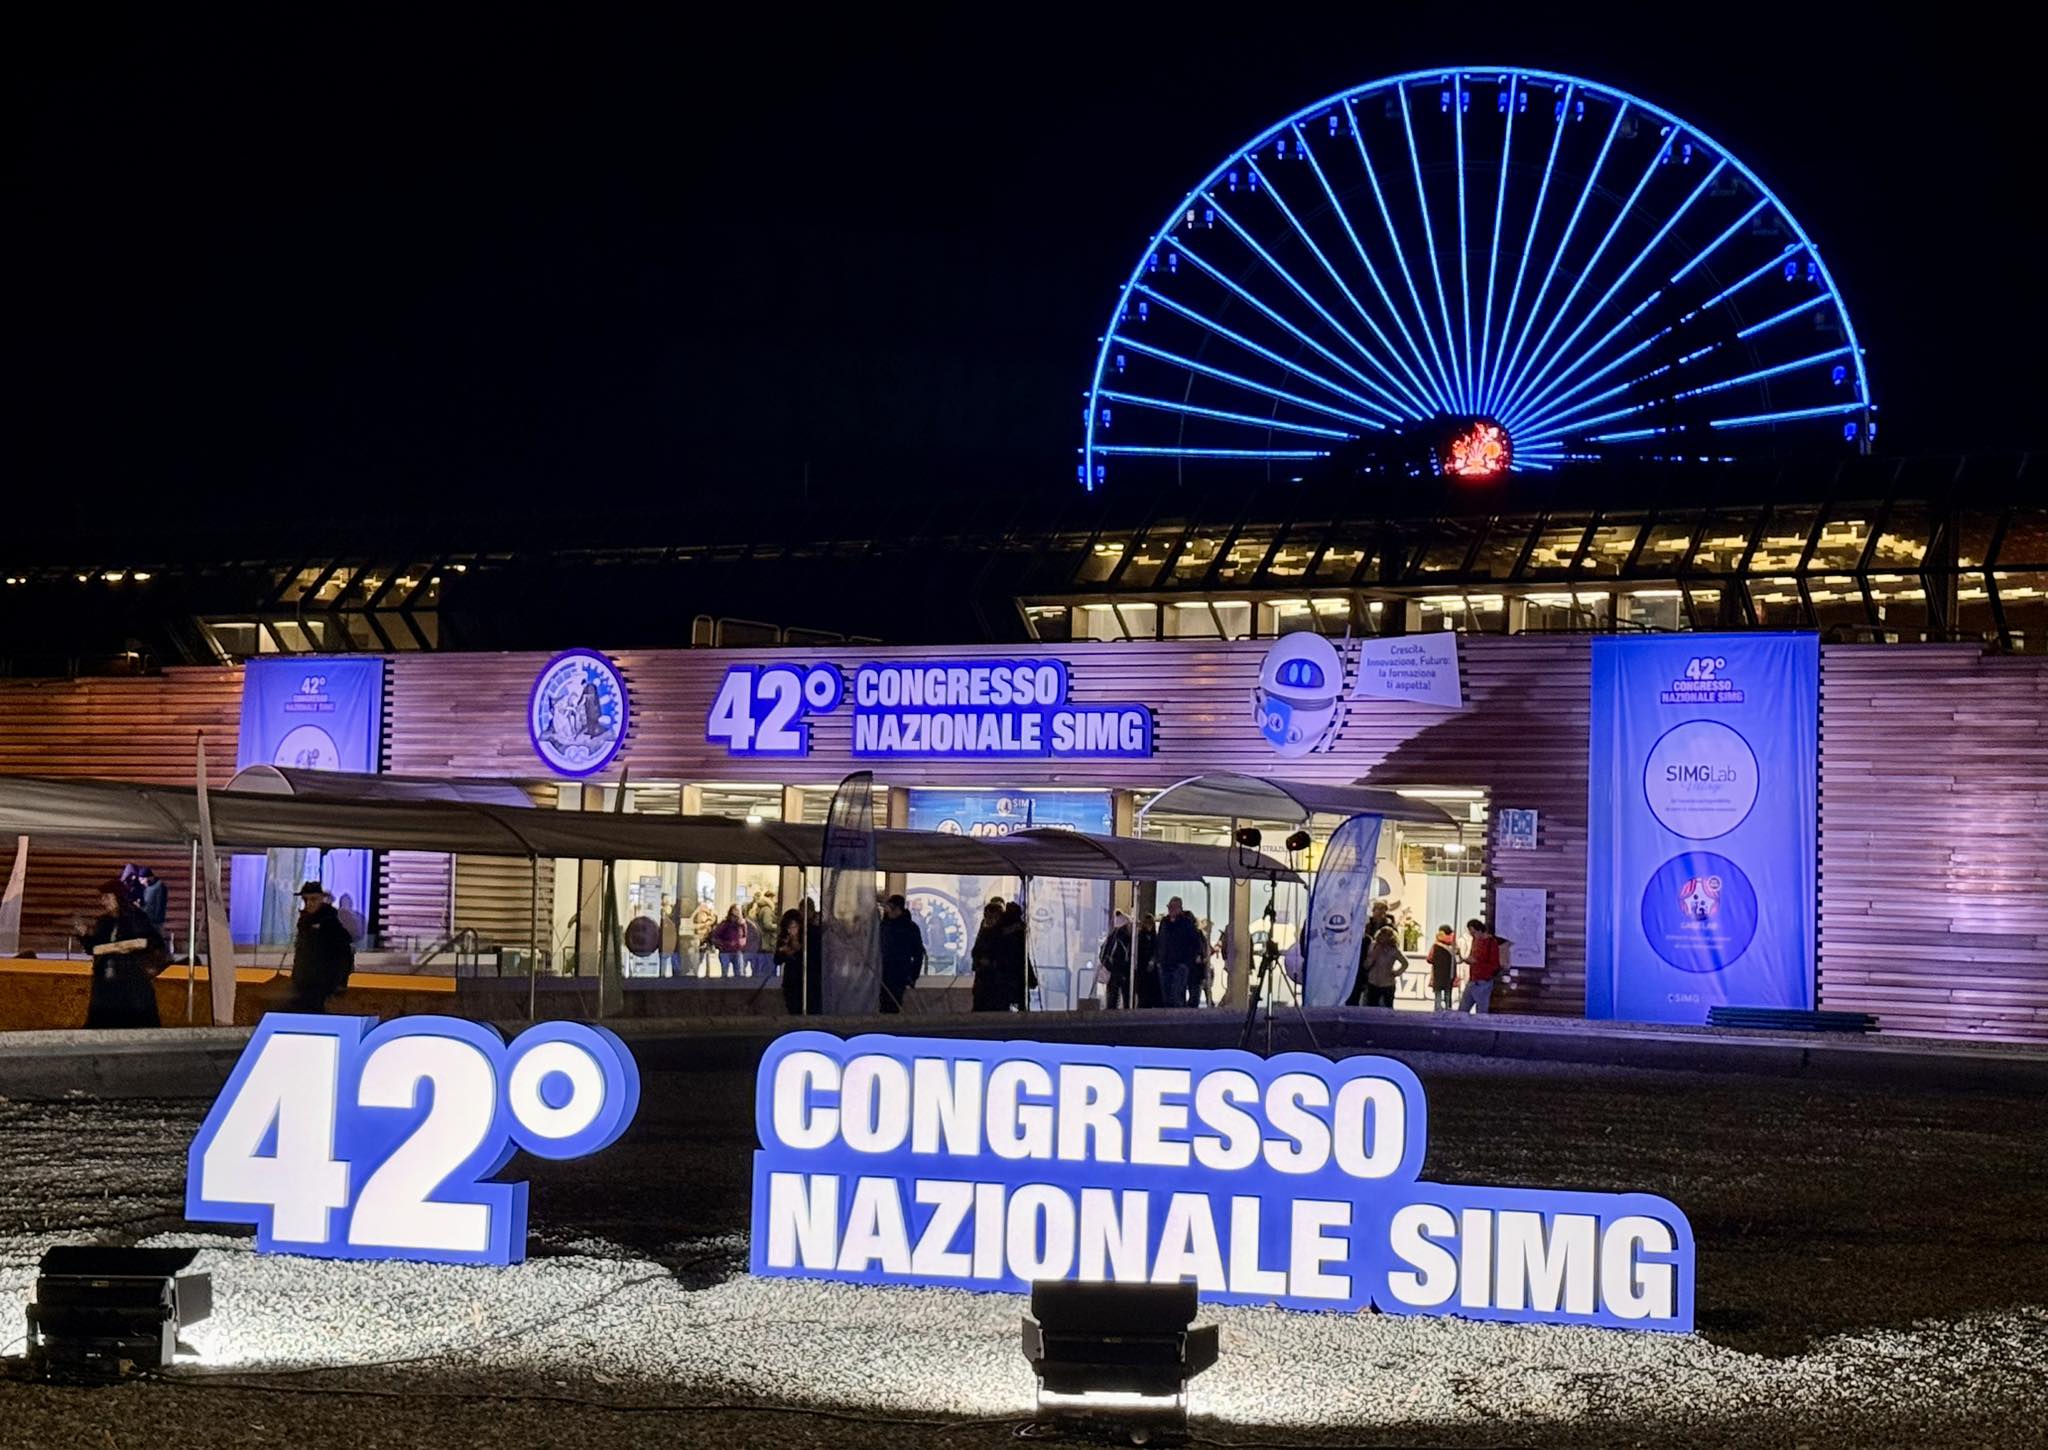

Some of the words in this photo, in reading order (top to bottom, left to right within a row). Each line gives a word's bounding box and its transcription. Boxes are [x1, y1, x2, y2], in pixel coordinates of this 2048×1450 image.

[1390, 644, 1426, 654] Crescita,
[1378, 669, 1386, 678] la
[1389, 669, 1436, 678] formazione
[1685, 658, 1725, 680] 42°
[301, 677, 327, 694] 42°
[856, 666, 1059, 707] CONGRESSO
[1386, 681, 1393, 689] ti
[1395, 680, 1431, 692] aspetta!
[1673, 681, 1732, 691] CONGRESSO
[708, 668, 836, 750] 42°
[855, 713, 1043, 752] NAZIONALE
[1051, 711, 1143, 751] SIMG
[1666, 765, 1737, 782] SIMGLab
[773, 1051, 1405, 1179] CONGRESSO
[201, 1033, 605, 1252] 42°
[767, 1172, 1352, 1300] NAZIONALE
[1388, 1203, 1675, 1320] SIMG
